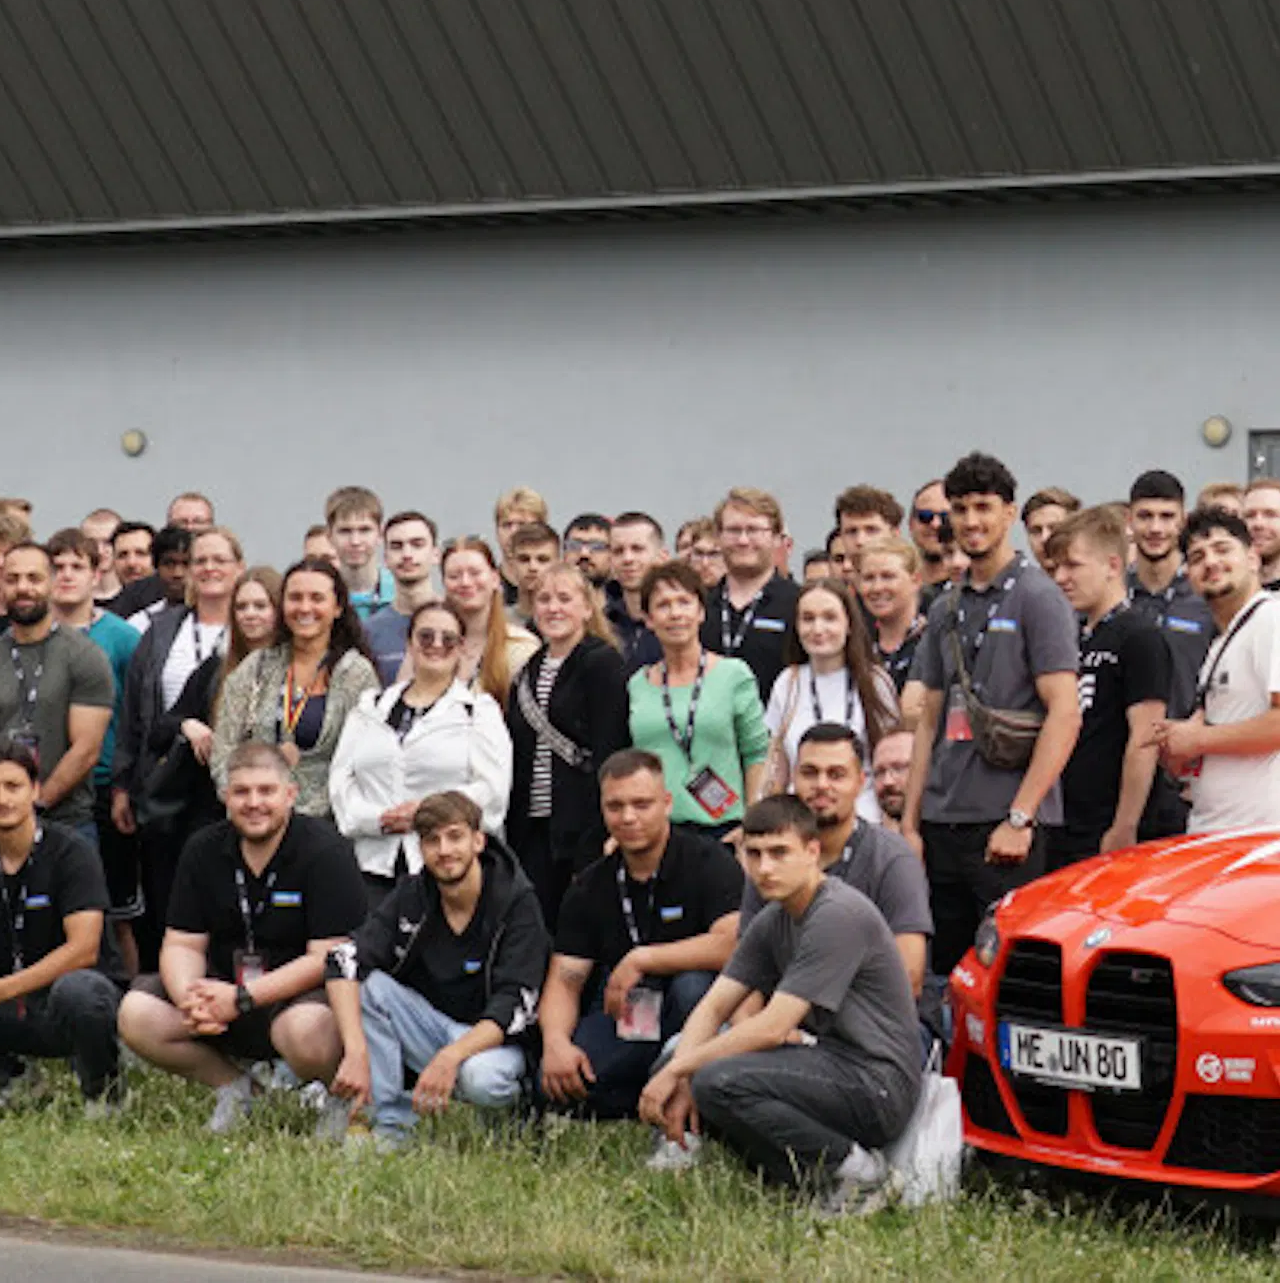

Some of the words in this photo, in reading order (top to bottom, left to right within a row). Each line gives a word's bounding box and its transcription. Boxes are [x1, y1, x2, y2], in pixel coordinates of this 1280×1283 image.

[1017, 1034, 1044, 1069] ME
[1058, 1039, 1091, 1075] UN
[1096, 1043, 1127, 1081] 80
